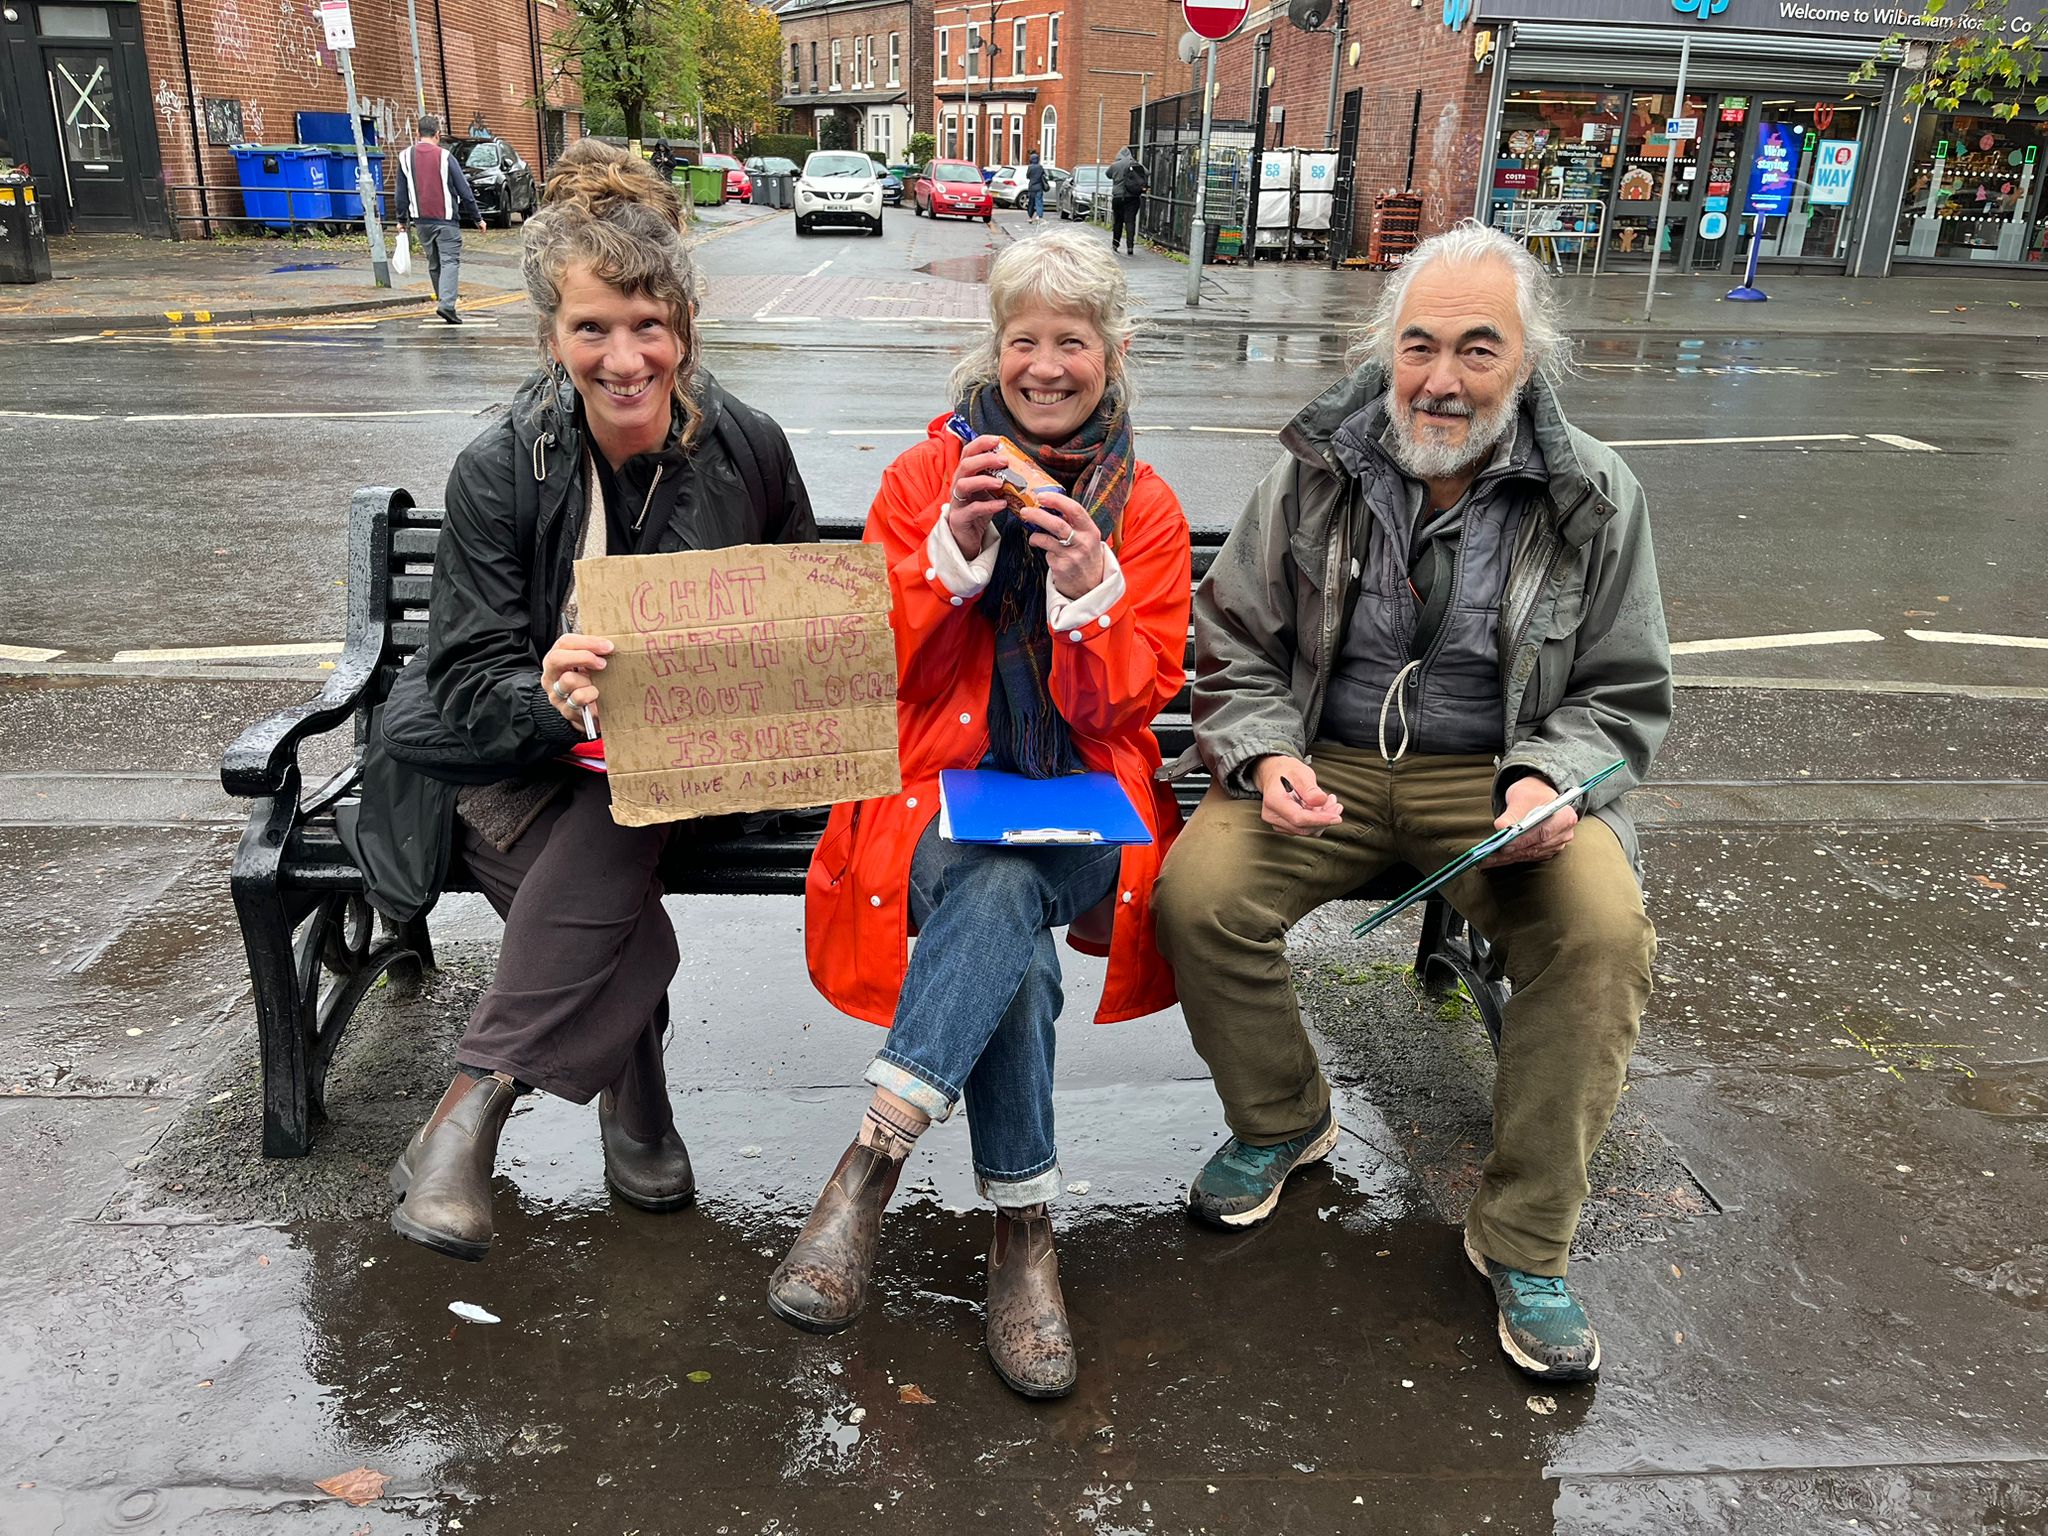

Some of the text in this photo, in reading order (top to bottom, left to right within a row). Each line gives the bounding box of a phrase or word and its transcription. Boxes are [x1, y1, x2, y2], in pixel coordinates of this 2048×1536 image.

[1780, 2, 1850, 22] Welcome
[1853, 9, 1869, 23] to
[1764, 145, 1787, 157] We're
[1757, 160, 1789, 172] staying
[756, 179, 762, 187] 3
[772, 179, 777, 187] 3
[1818, 168, 1851, 187] WAY
[632, 566, 766, 633] CHAT
[806, 616, 866, 664] US
[644, 672, 897, 725] ABOUT LOCAL
[667, 718, 842, 768] ISSUES
[681, 777, 723, 798] HAVE
[739, 773, 753, 790] A
[768, 767, 824, 788] SNACK
